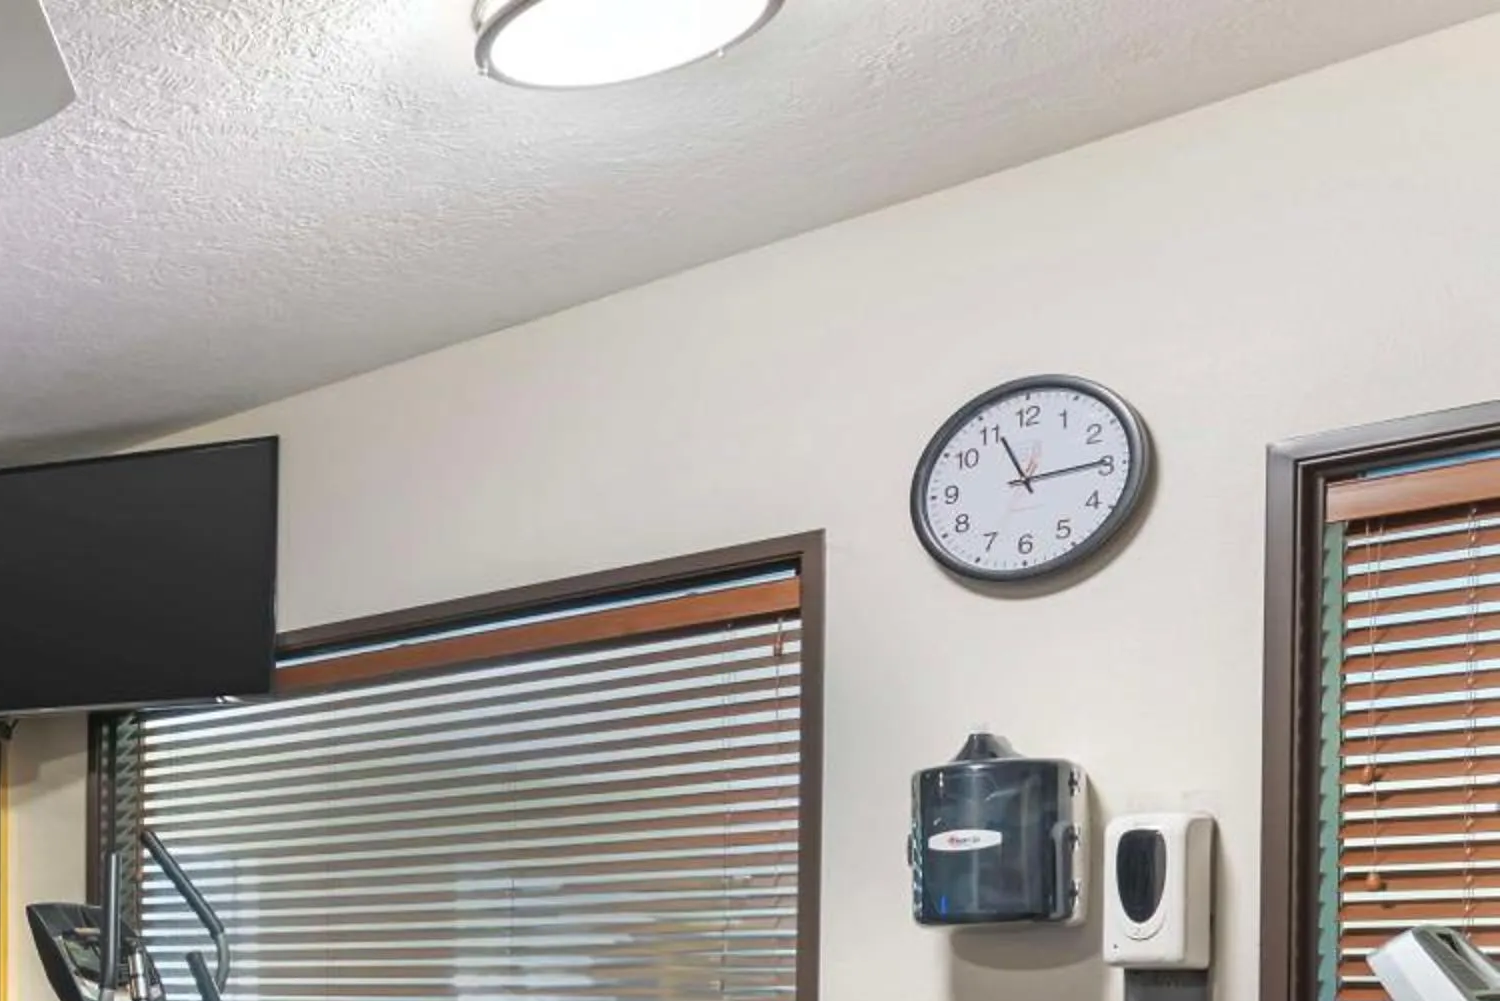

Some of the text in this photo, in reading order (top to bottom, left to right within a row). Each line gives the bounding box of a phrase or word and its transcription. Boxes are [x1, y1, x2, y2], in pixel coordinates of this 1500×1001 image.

[1016, 405, 1041, 428] 12
[1059, 409, 1068, 429] 1
[979, 424, 1001, 445] 11
[1086, 423, 1102, 444] 2
[956, 448, 979, 469] 10
[1097, 455, 1115, 476] 3
[944, 485, 959, 504] 9
[1085, 490, 1101, 510] 4
[955, 513, 970, 533] 8
[1056, 519, 1071, 540] 5
[983, 531, 998, 552] 7
[1017, 534, 1033, 554] 6
